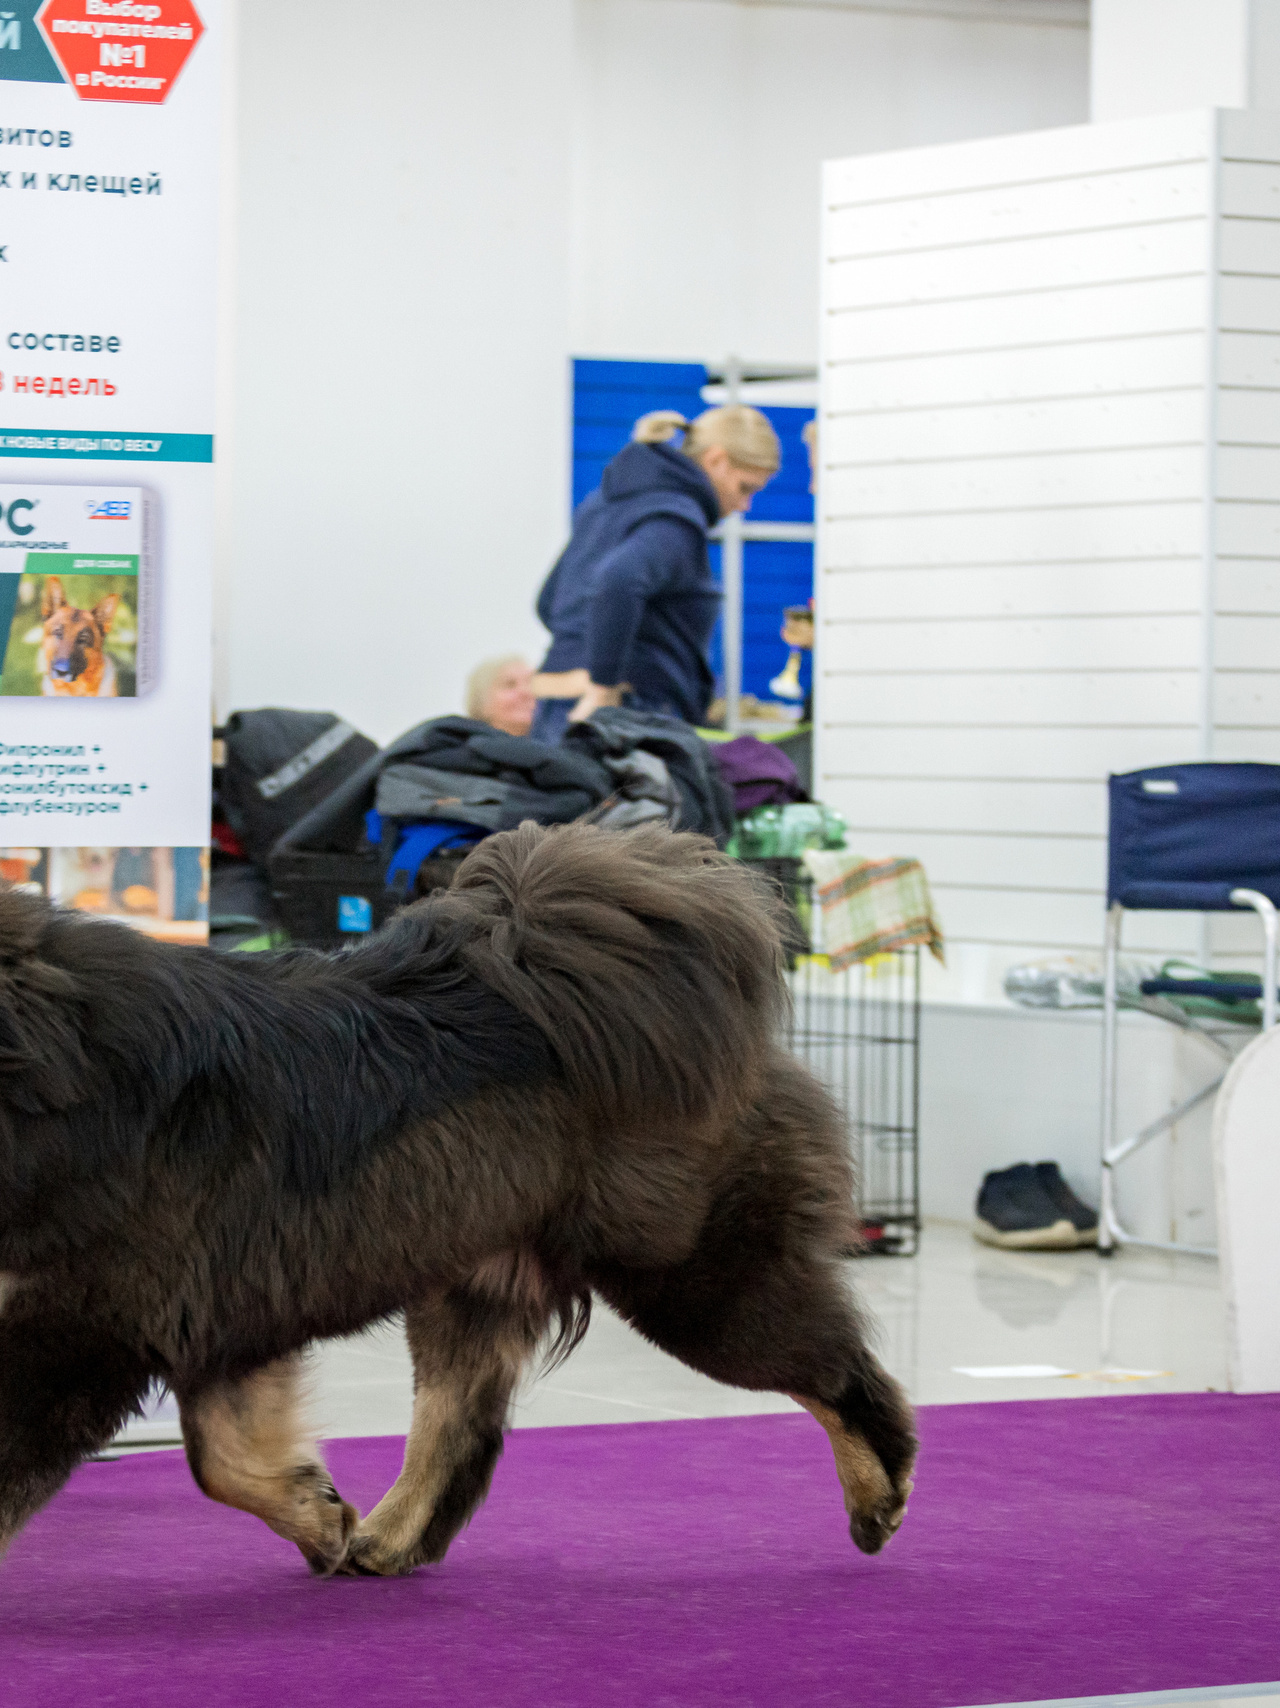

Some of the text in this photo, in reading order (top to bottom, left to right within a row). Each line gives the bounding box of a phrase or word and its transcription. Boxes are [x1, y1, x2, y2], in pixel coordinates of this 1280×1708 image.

[85, 0, 161, 21] Выбор
[52, 19, 193, 40] покупателей
[99, 43, 146, 68] №1
[75, 73, 89, 86] в
[21, 171, 38, 191] и
[47, 171, 163, 197] клещей
[7, 332, 122, 354] составе
[13, 375, 118, 398] недель
[7, 435, 57, 450] НОВЫЕ
[124, 439, 163, 453] ВЕСУ
